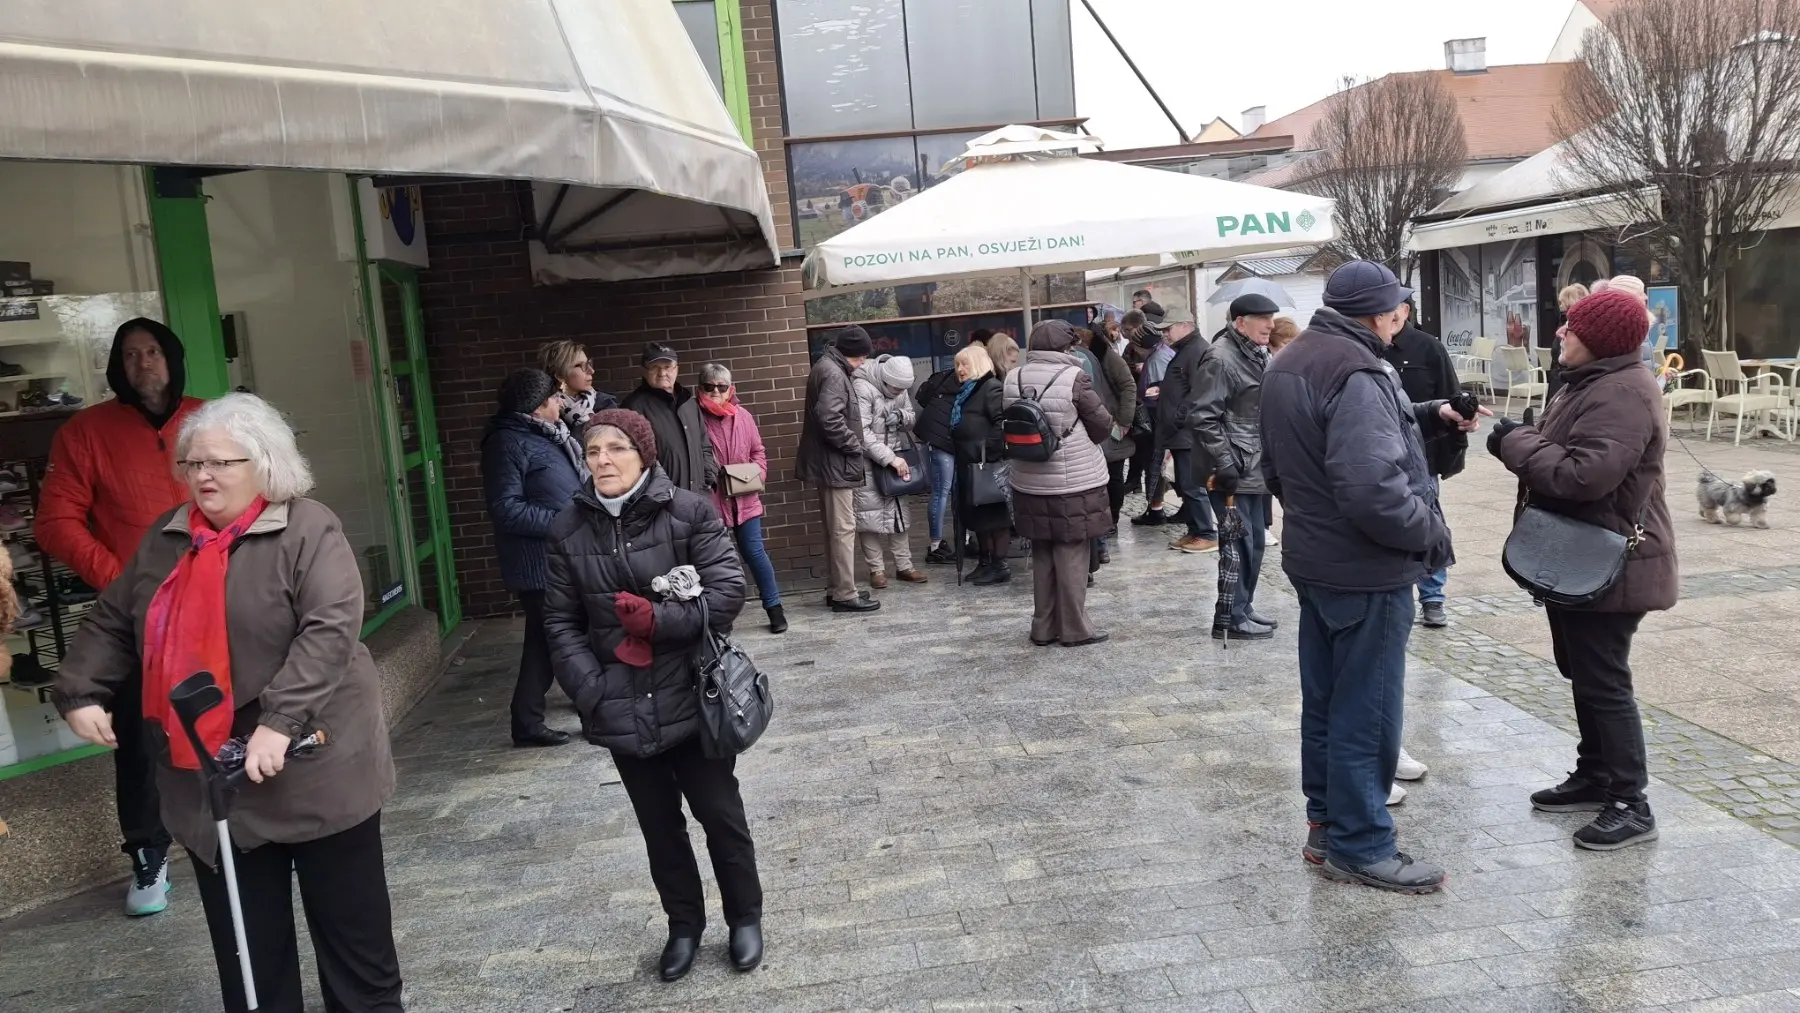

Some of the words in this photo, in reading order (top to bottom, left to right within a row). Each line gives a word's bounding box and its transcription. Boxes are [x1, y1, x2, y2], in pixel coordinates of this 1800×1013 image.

[1216, 211, 1291, 238] PAN
[844, 251, 903, 269] POZOVI
[909, 249, 931, 262] NA
[937, 245, 973, 259] PAN,
[978, 236, 1041, 256] OSVJEŽI
[1046, 235, 1085, 249] DAN!
